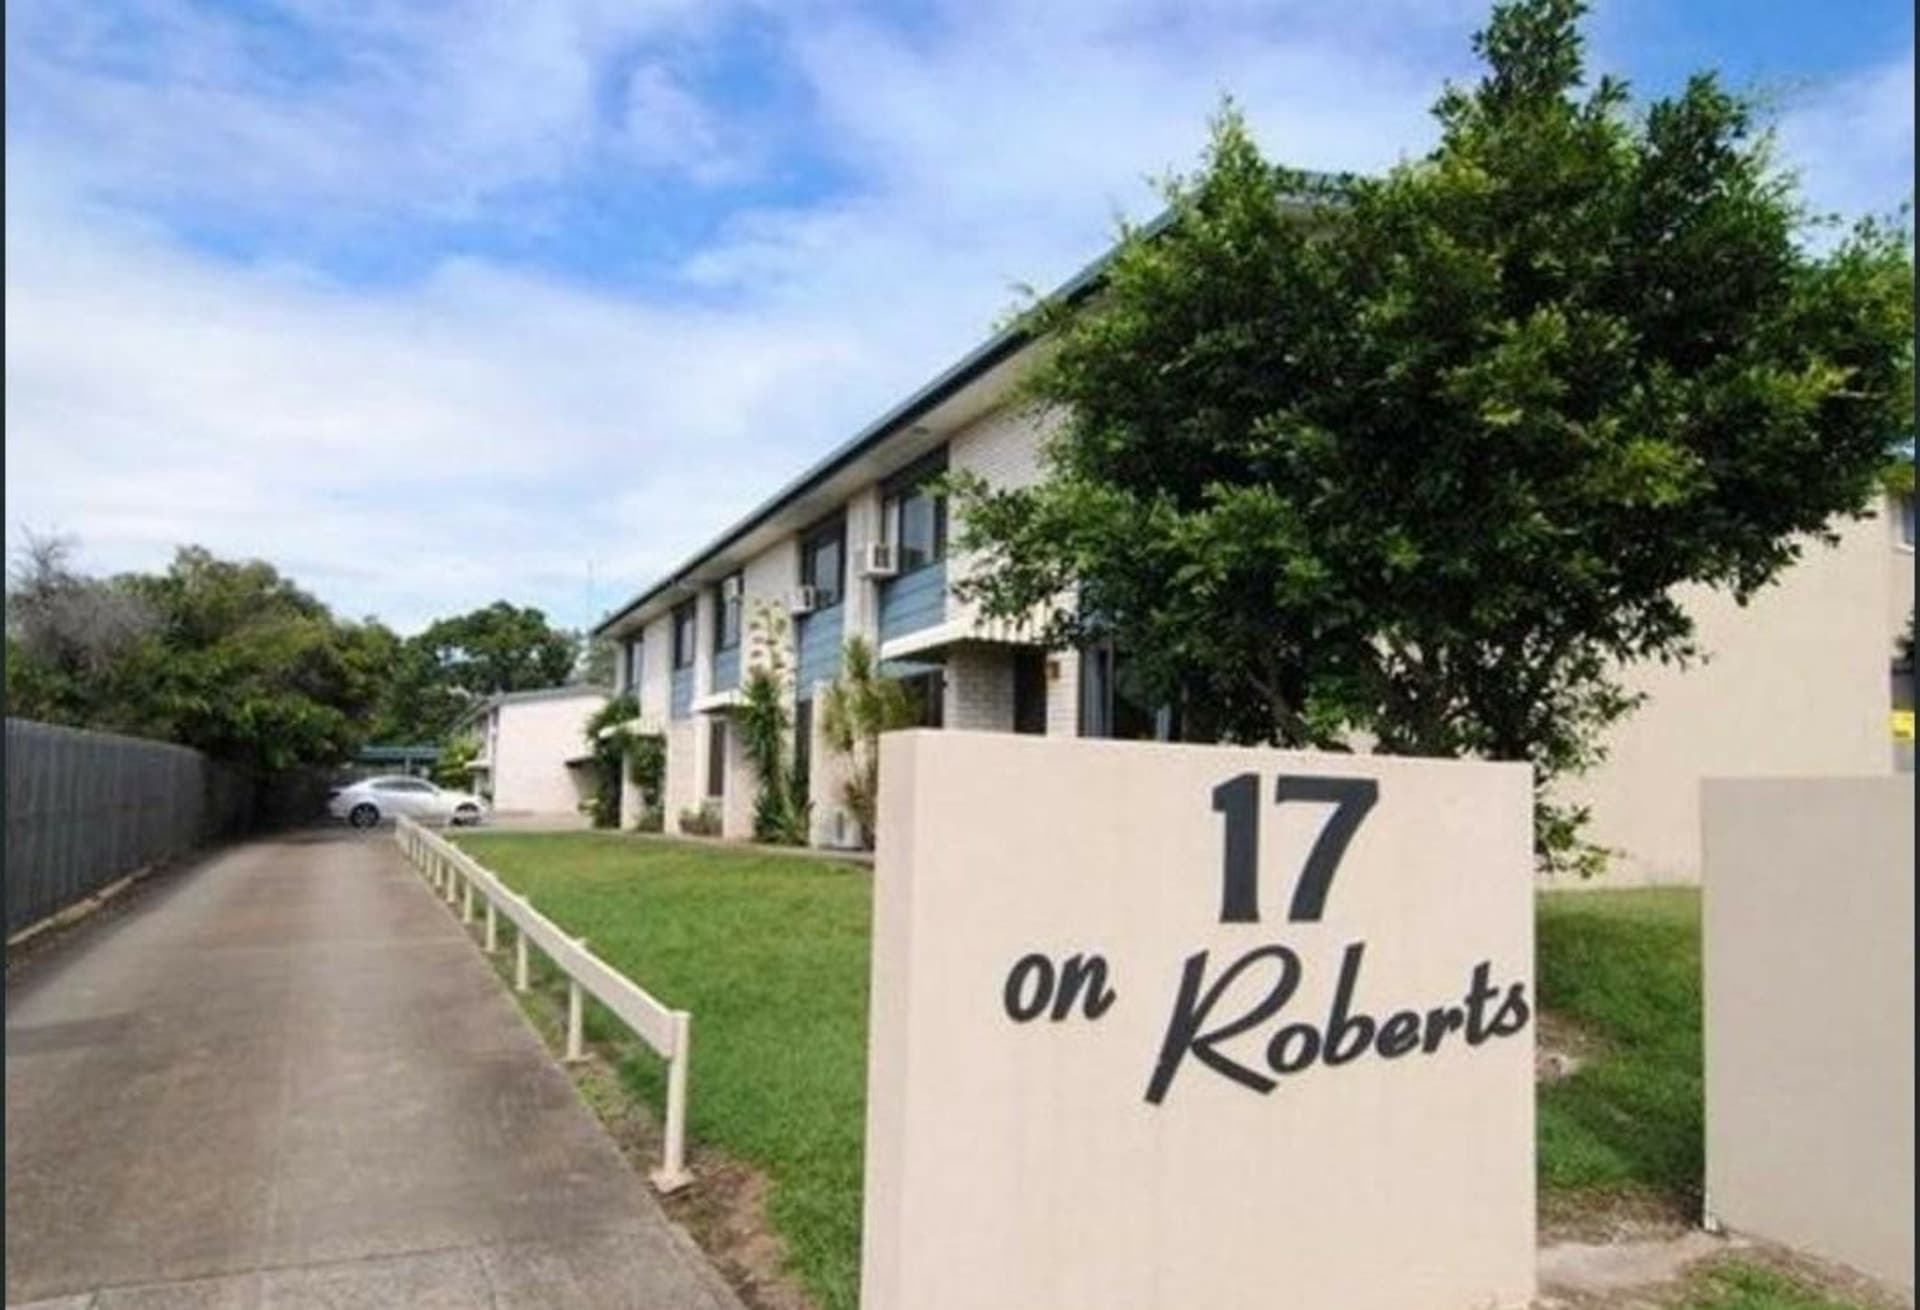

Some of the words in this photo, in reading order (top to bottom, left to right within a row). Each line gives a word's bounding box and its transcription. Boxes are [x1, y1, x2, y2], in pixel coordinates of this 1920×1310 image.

[1211, 772, 1380, 924] 17
[1003, 952, 1117, 1024] on
[1144, 942, 1531, 1106] Roberts
